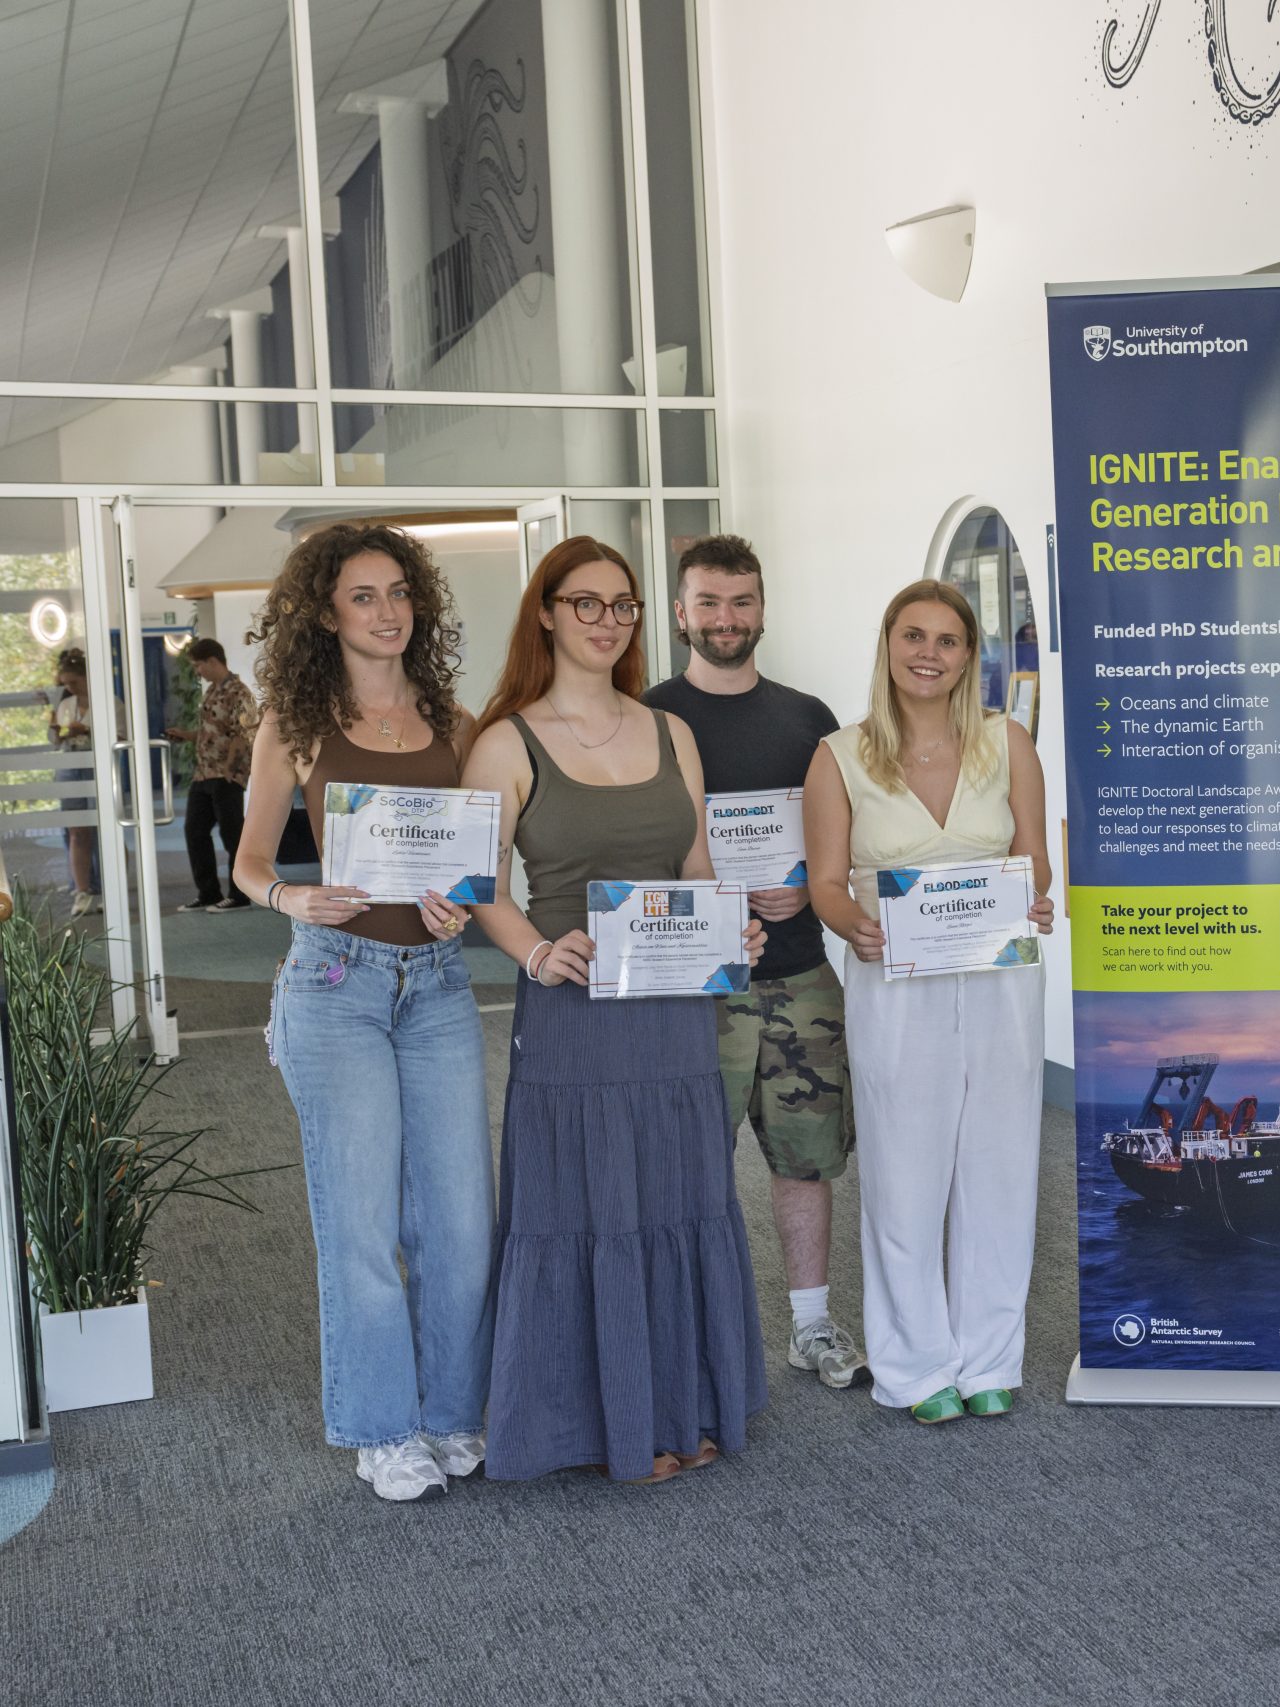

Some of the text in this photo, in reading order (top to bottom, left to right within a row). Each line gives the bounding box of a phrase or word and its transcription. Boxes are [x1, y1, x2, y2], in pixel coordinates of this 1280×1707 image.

[1126, 323, 1204, 340] University of
[1112, 336, 1248, 358] Southampton
[1089, 451, 1209, 485] IGNITE:
[1090, 494, 1269, 528] Generation
[1092, 540, 1243, 572] Research
[1094, 623, 1156, 639] Funded
[1160, 622, 1196, 638] PhD
[1095, 662, 1171, 678] Research
[1176, 660, 1246, 680] projects
[1120, 693, 1269, 710] Oceans and climate
[1121, 718, 1264, 737] The dynamic Earth
[1121, 742, 1205, 757] Interaction
[1209, 741, 1225, 756] of
[1098, 785, 1139, 798] IGNITE
[1142, 785, 1194, 798] Doctoral
[1198, 783, 1261, 799] Landscape
[380, 796, 433, 808] SoCoBio
[1098, 804, 1144, 819] develop
[1147, 804, 1166, 816] the
[1170, 804, 1196, 815] next
[1199, 802, 1262, 817] generation
[1267, 801, 1280, 814] of
[370, 823, 456, 840] Certificate
[710, 823, 783, 838] Certificate
[1099, 823, 1110, 834] to
[1114, 822, 1138, 834] lead
[1141, 825, 1162, 835] our
[1165, 821, 1226, 836] responses
[1229, 820, 1242, 833] to
[396, 840, 438, 848] completion
[734, 836, 770, 844] completion
[1099, 839, 1159, 856] challenges
[1162, 840, 1185, 853] and
[1188, 839, 1219, 852] meet
[1222, 839, 1243, 852] the
[1246, 838, 1280, 851] needs
[920, 898, 996, 916] Certificate
[1101, 903, 1248, 920] Take your project to
[945, 912, 982, 921] completion
[630, 918, 709, 932] Certificate
[1102, 921, 1262, 936] the next level with us.
[655, 933, 693, 941] completion
[1102, 945, 1232, 957] Scan here to find out how
[1103, 960, 1213, 973] we can work with you.
[1193, 1328, 1223, 1337] Survey
